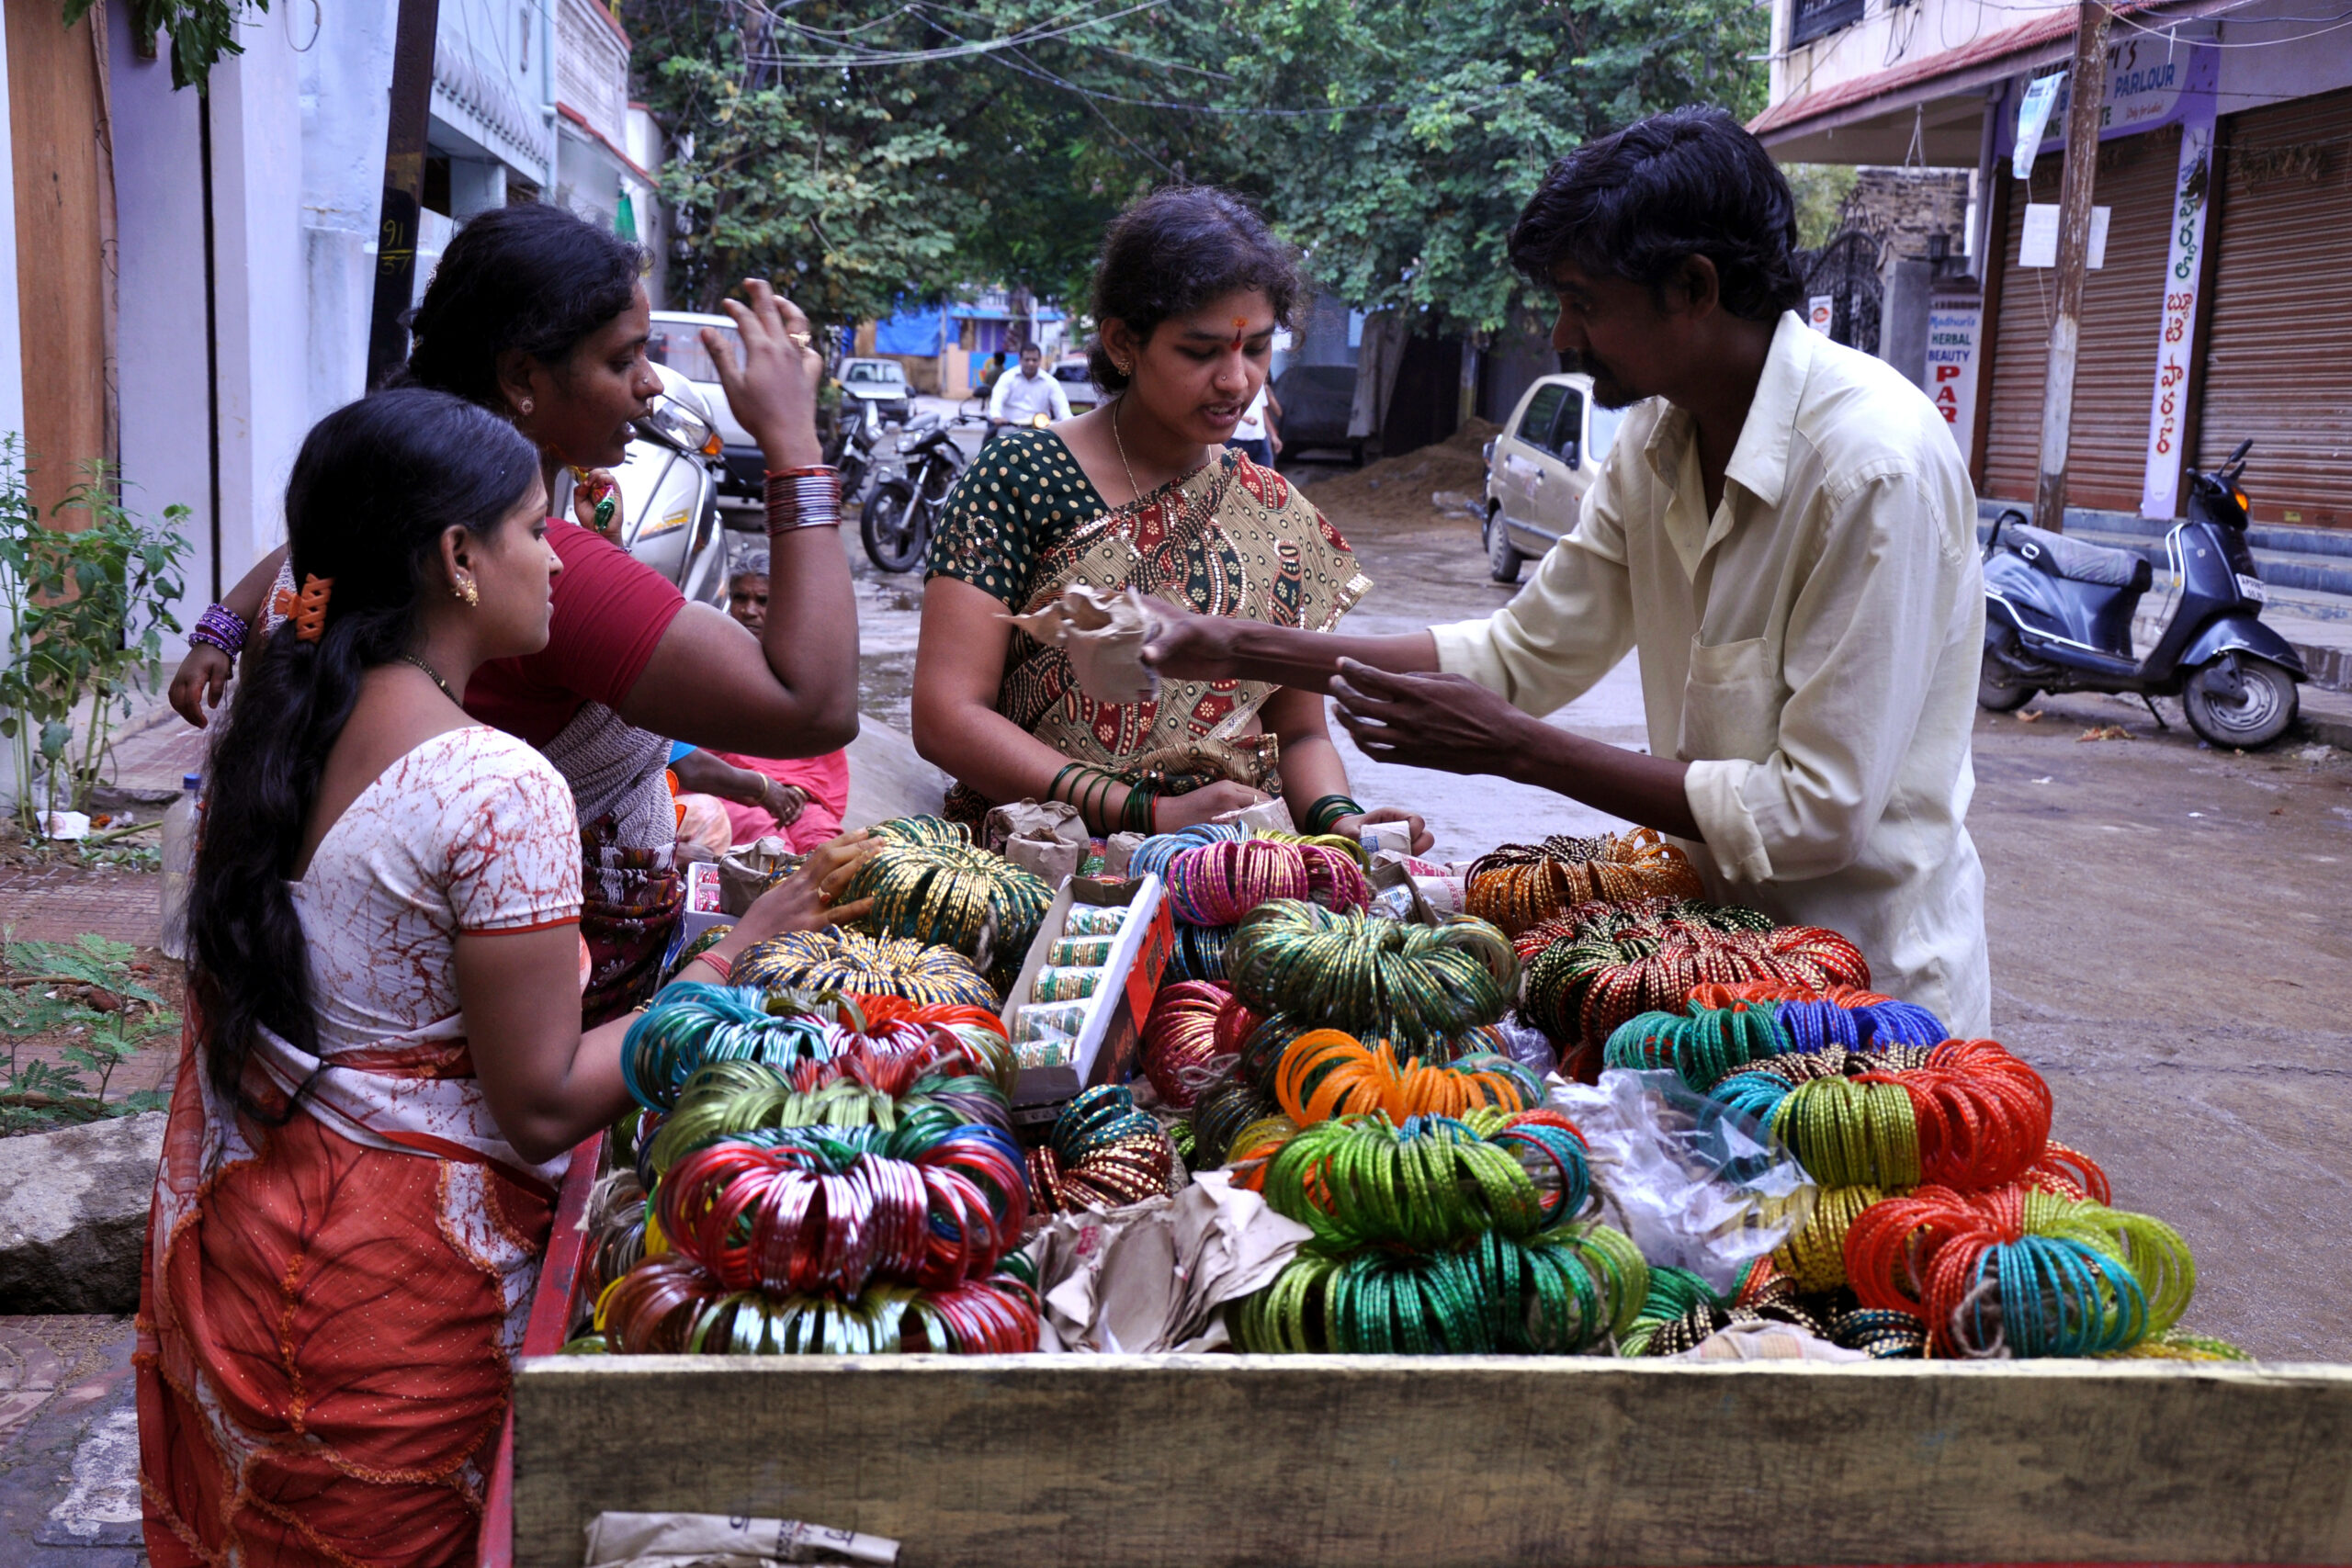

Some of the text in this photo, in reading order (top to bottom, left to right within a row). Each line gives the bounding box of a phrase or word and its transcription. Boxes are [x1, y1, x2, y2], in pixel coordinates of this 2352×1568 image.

[2114, 63, 2175, 98] PARLOUR
[382, 219, 404, 247] 91
[1931, 332, 1972, 346] HERBAL
[1928, 349, 1971, 363] BEAUTY
